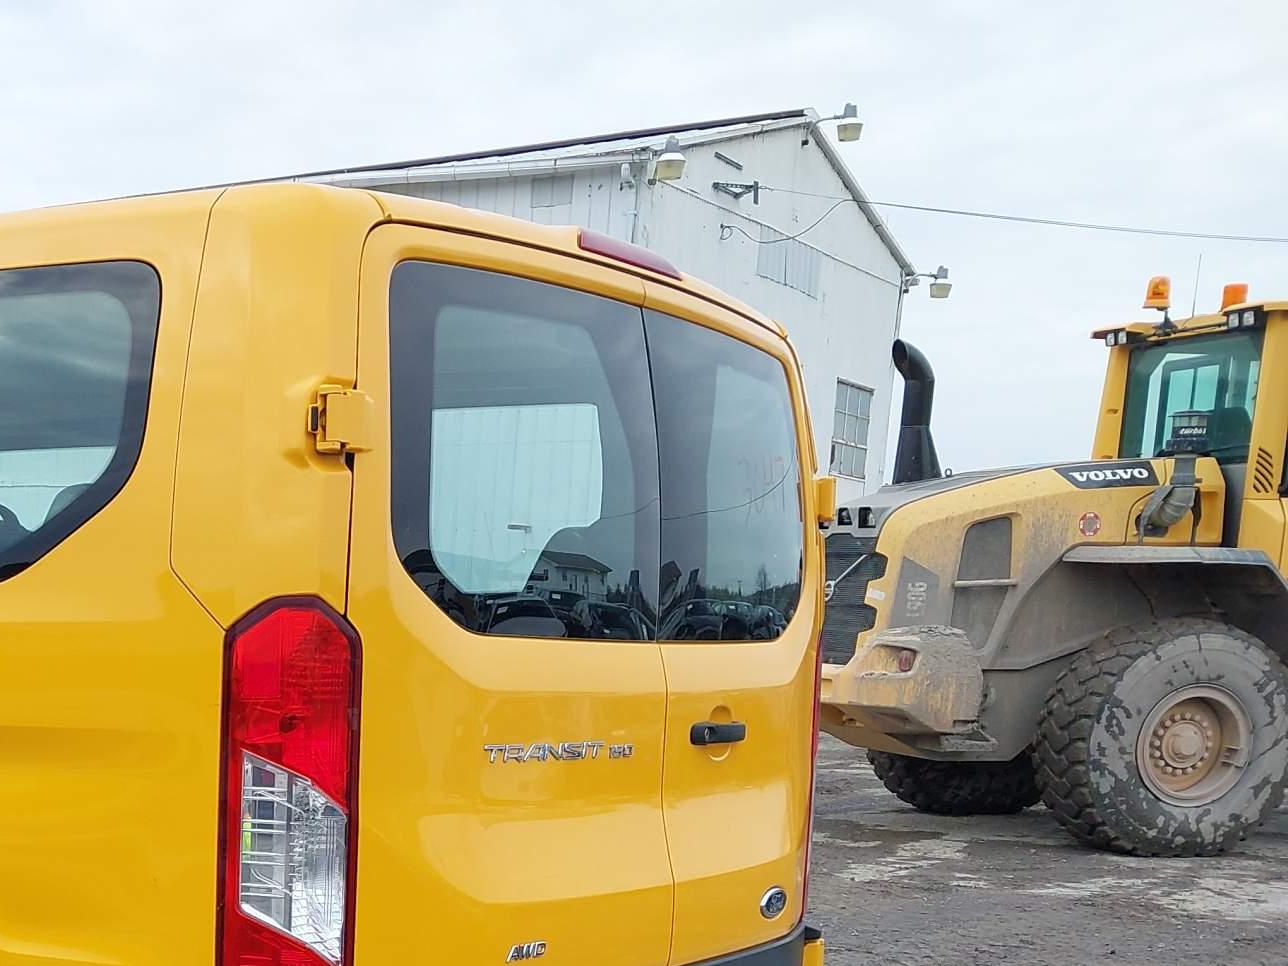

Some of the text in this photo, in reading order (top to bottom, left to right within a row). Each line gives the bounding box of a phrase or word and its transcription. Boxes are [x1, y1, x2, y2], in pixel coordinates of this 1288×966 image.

[1068, 467, 1149, 482] VOLVO
[484, 740, 605, 763] TRANSIT
[505, 940, 547, 964] AWD
